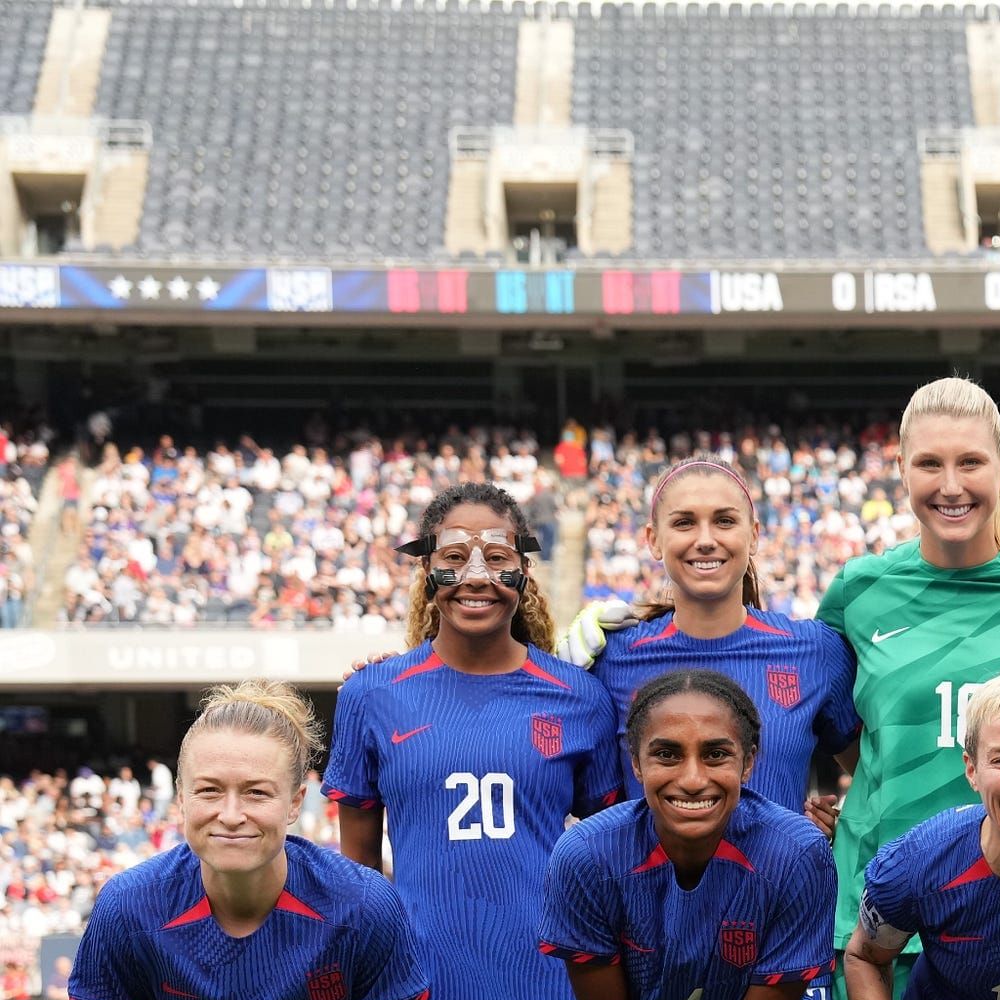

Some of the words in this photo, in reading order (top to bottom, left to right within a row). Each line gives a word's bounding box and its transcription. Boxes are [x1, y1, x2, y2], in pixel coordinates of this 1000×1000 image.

[721, 272, 784, 311] USA
[832, 272, 857, 311] 0
[874, 272, 937, 312] RSA
[108, 646, 256, 670] UNITED
[768, 673, 796, 688] USA
[534, 722, 561, 738] USA
[445, 772, 516, 841] 20
[723, 930, 755, 946] USA
[310, 972, 341, 989] USA
